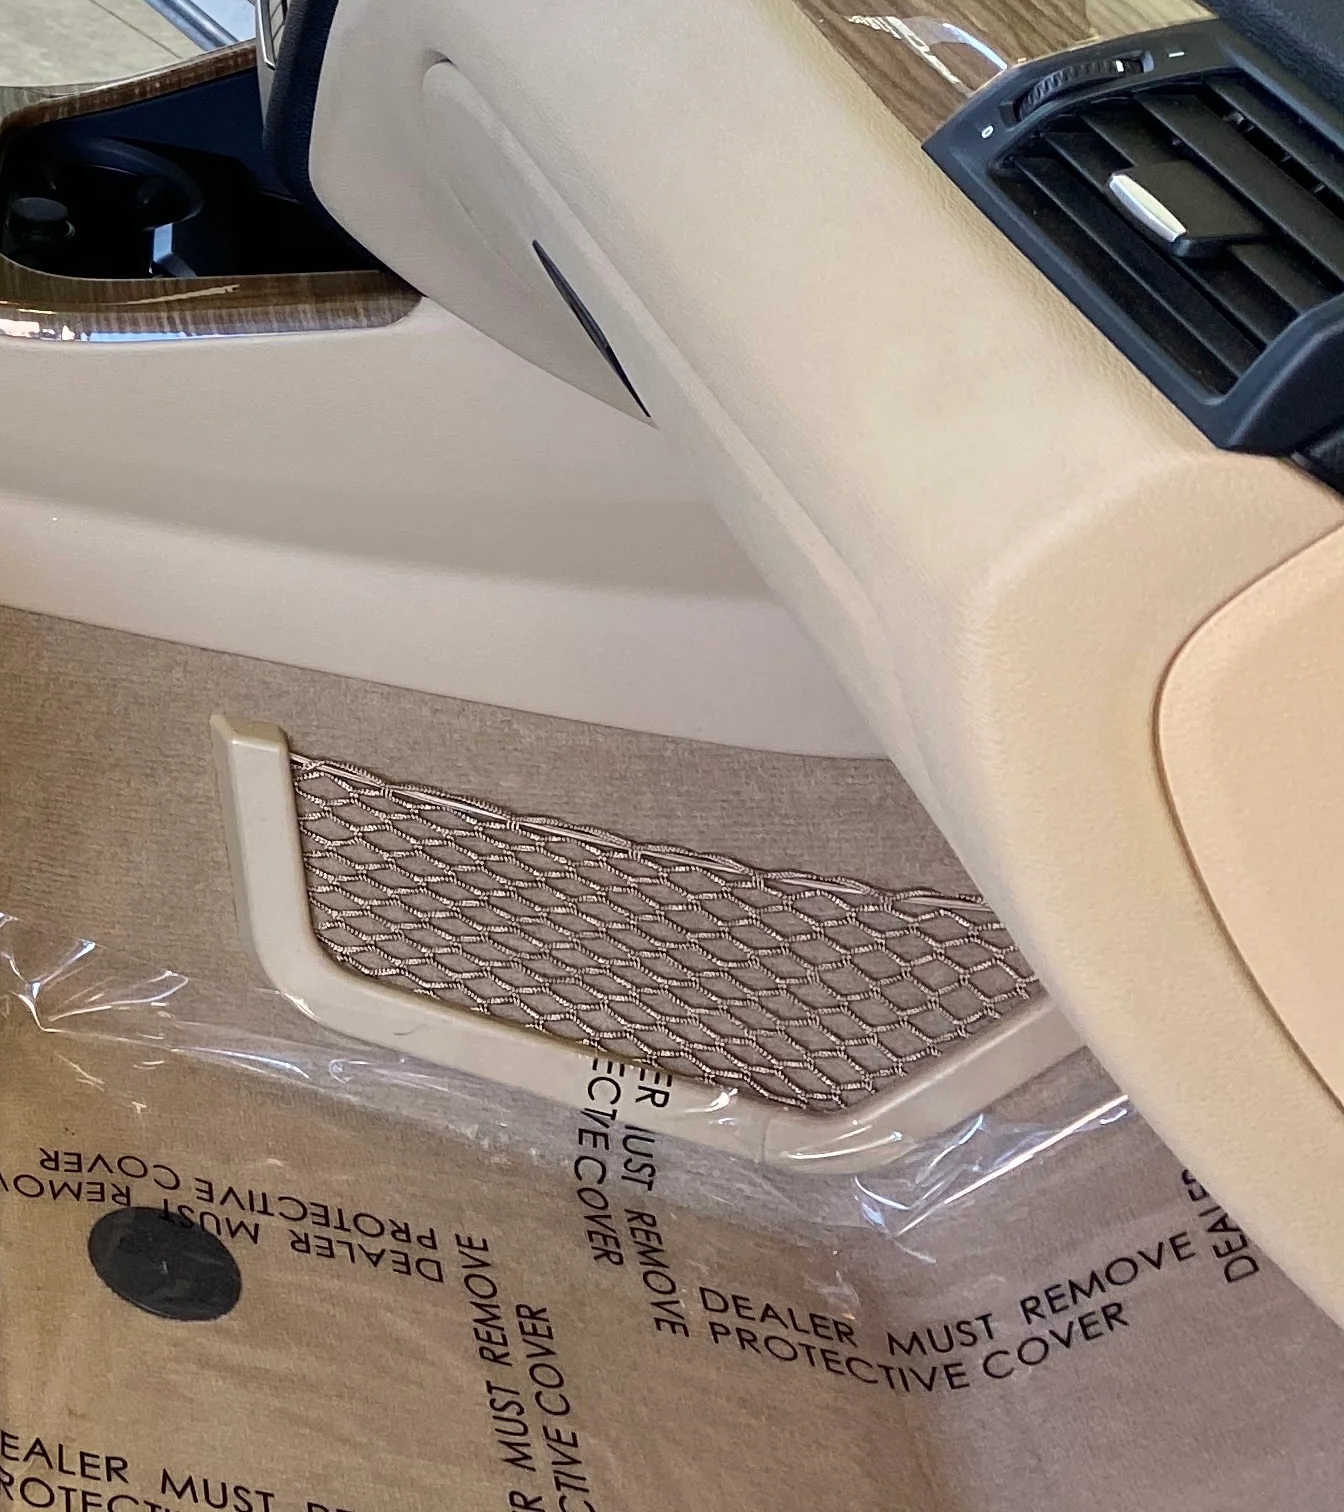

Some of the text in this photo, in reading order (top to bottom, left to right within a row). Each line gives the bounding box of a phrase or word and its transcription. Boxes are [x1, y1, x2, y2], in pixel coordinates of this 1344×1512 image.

[38, 1146, 438, 1250] PROTECTIVE COVER
[158, 1197, 260, 1245] MUST
[574, 1155, 625, 1266] COVER
[288, 1228, 444, 1283] DEALER
[454, 1233, 515, 1367] REMOVE
[624, 1208, 690, 1338] REMOVE
[698, 1230, 1197, 1357] DEALER MUST REMOVE
[514, 1302, 572, 1417] COVER
[708, 1301, 1130, 1393] PROTECTIVE COVER
[484, 1379, 537, 1473] MUST
[161, 1467, 275, 1512] MUST
